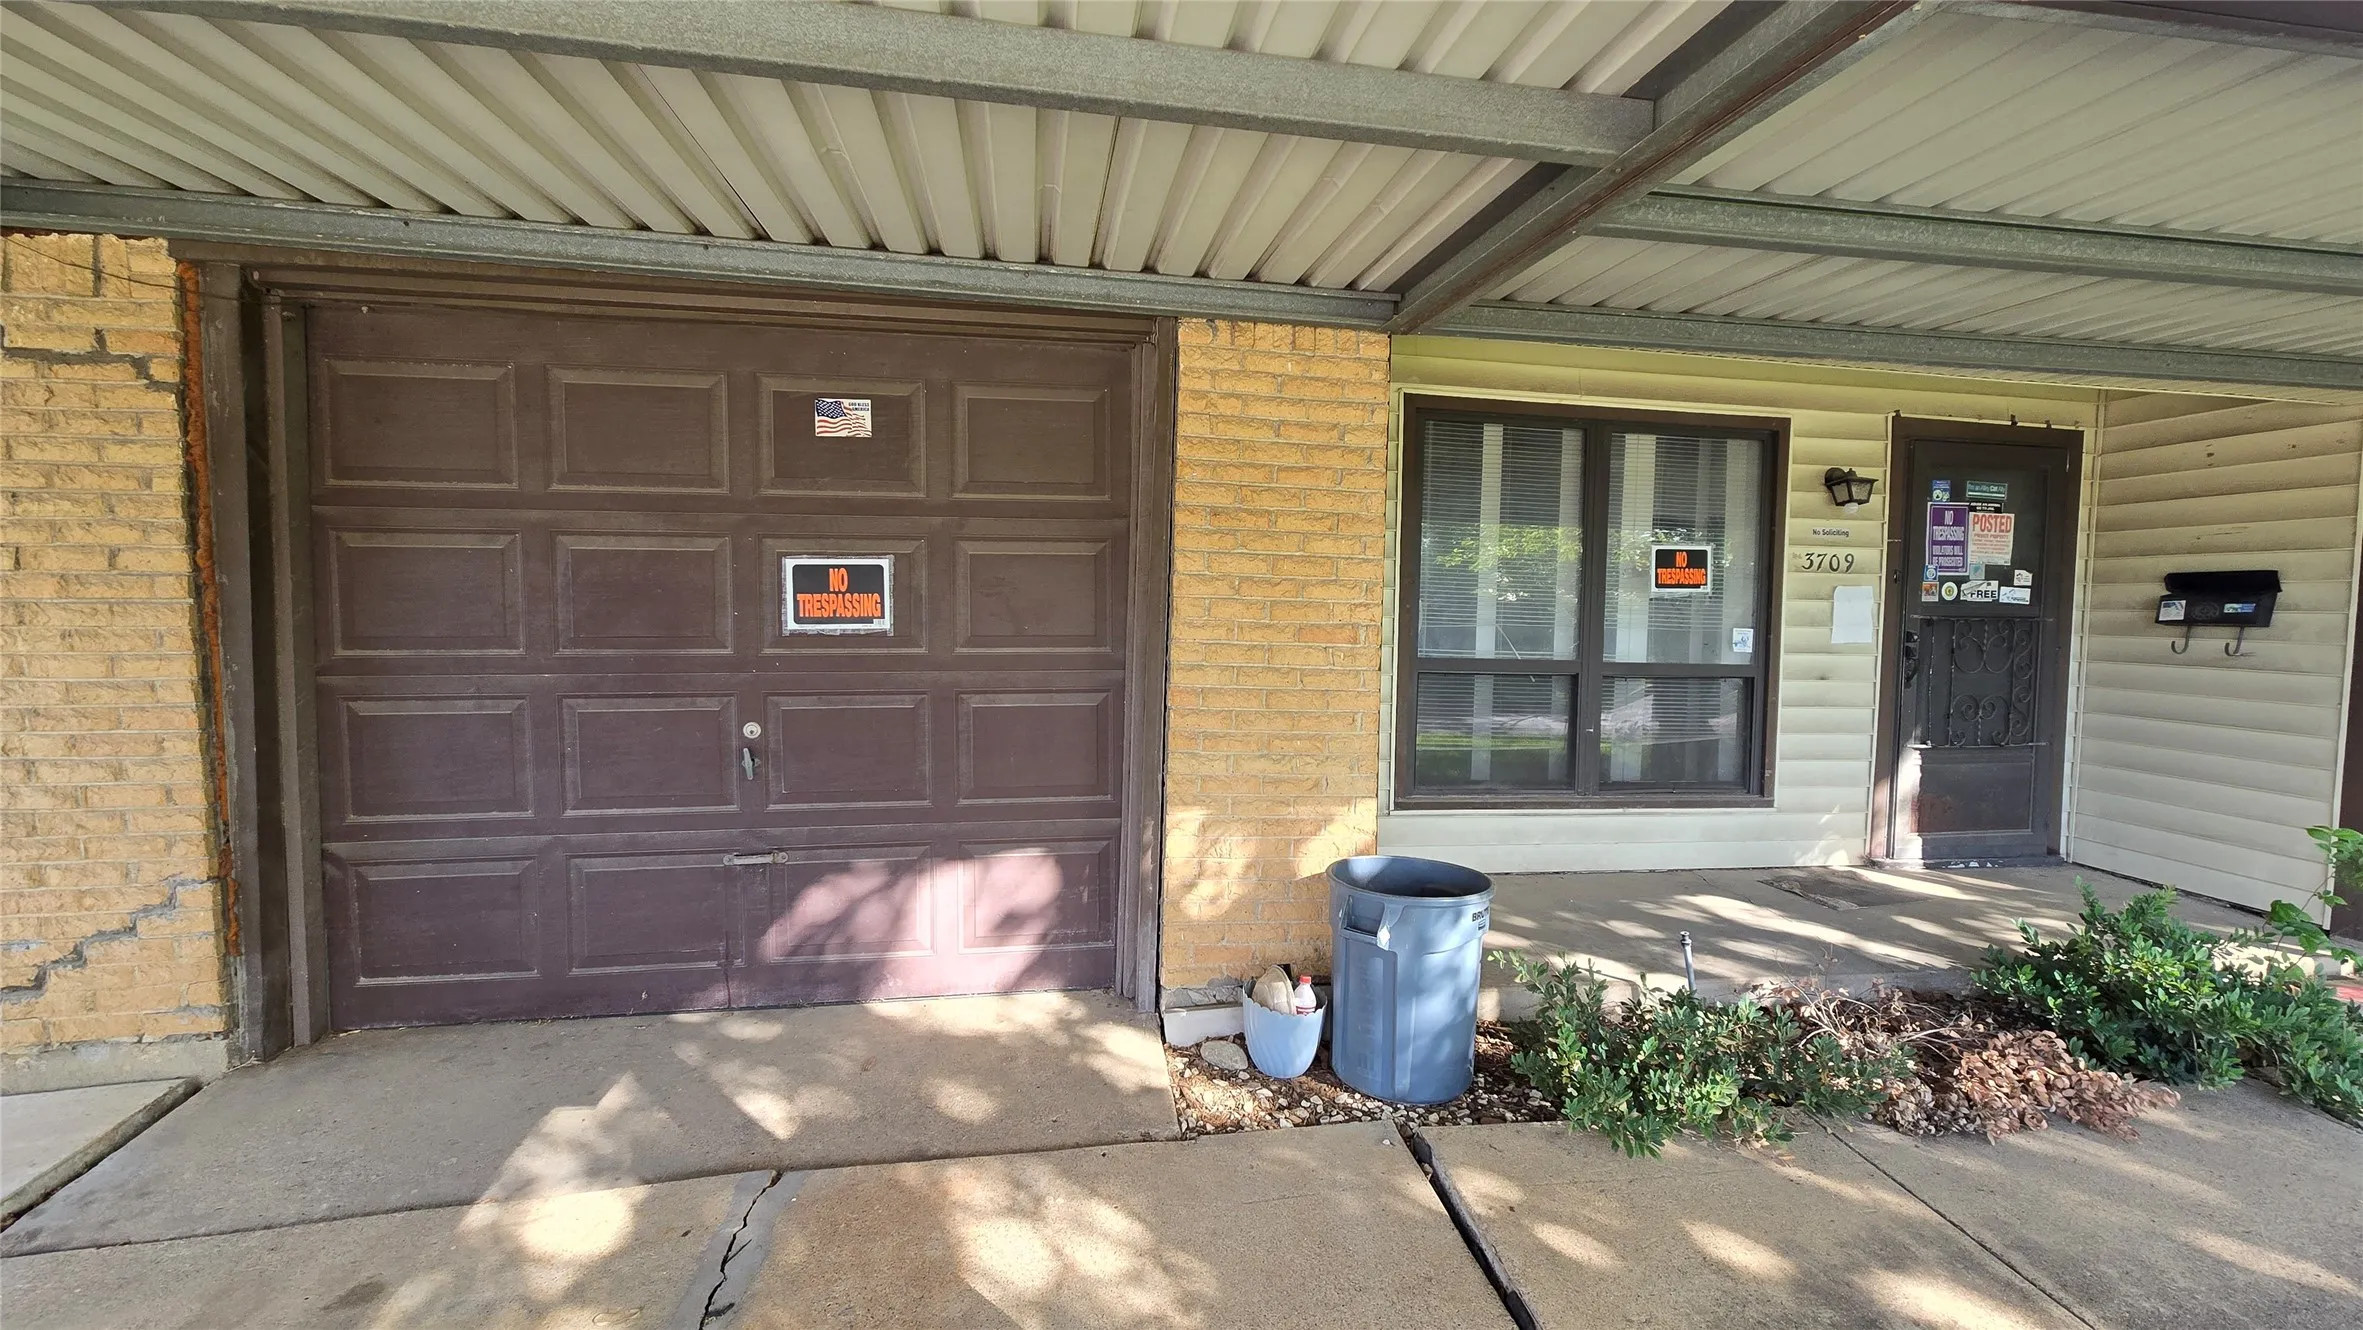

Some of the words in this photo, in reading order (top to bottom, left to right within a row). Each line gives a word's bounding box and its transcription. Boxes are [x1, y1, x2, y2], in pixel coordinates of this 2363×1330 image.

[1944, 510, 1954, 525] NO
[1972, 514, 2012, 533] POSTED
[1812, 528, 1821, 536] No
[1822, 528, 1849, 538] Soliciting
[1932, 526, 1965, 541] TRESPASSING
[1932, 545, 1953, 555] VIOLATORS
[1953, 545, 1963, 555] WILL
[1675, 551, 1688, 568] NO
[1801, 552, 1855, 573] 3709
[828, 567, 849, 592] NO
[1657, 568, 1706, 585] TRESPASSING
[1970, 590, 1997, 599] FREE
[796, 593, 881, 618] TRESPASSING
